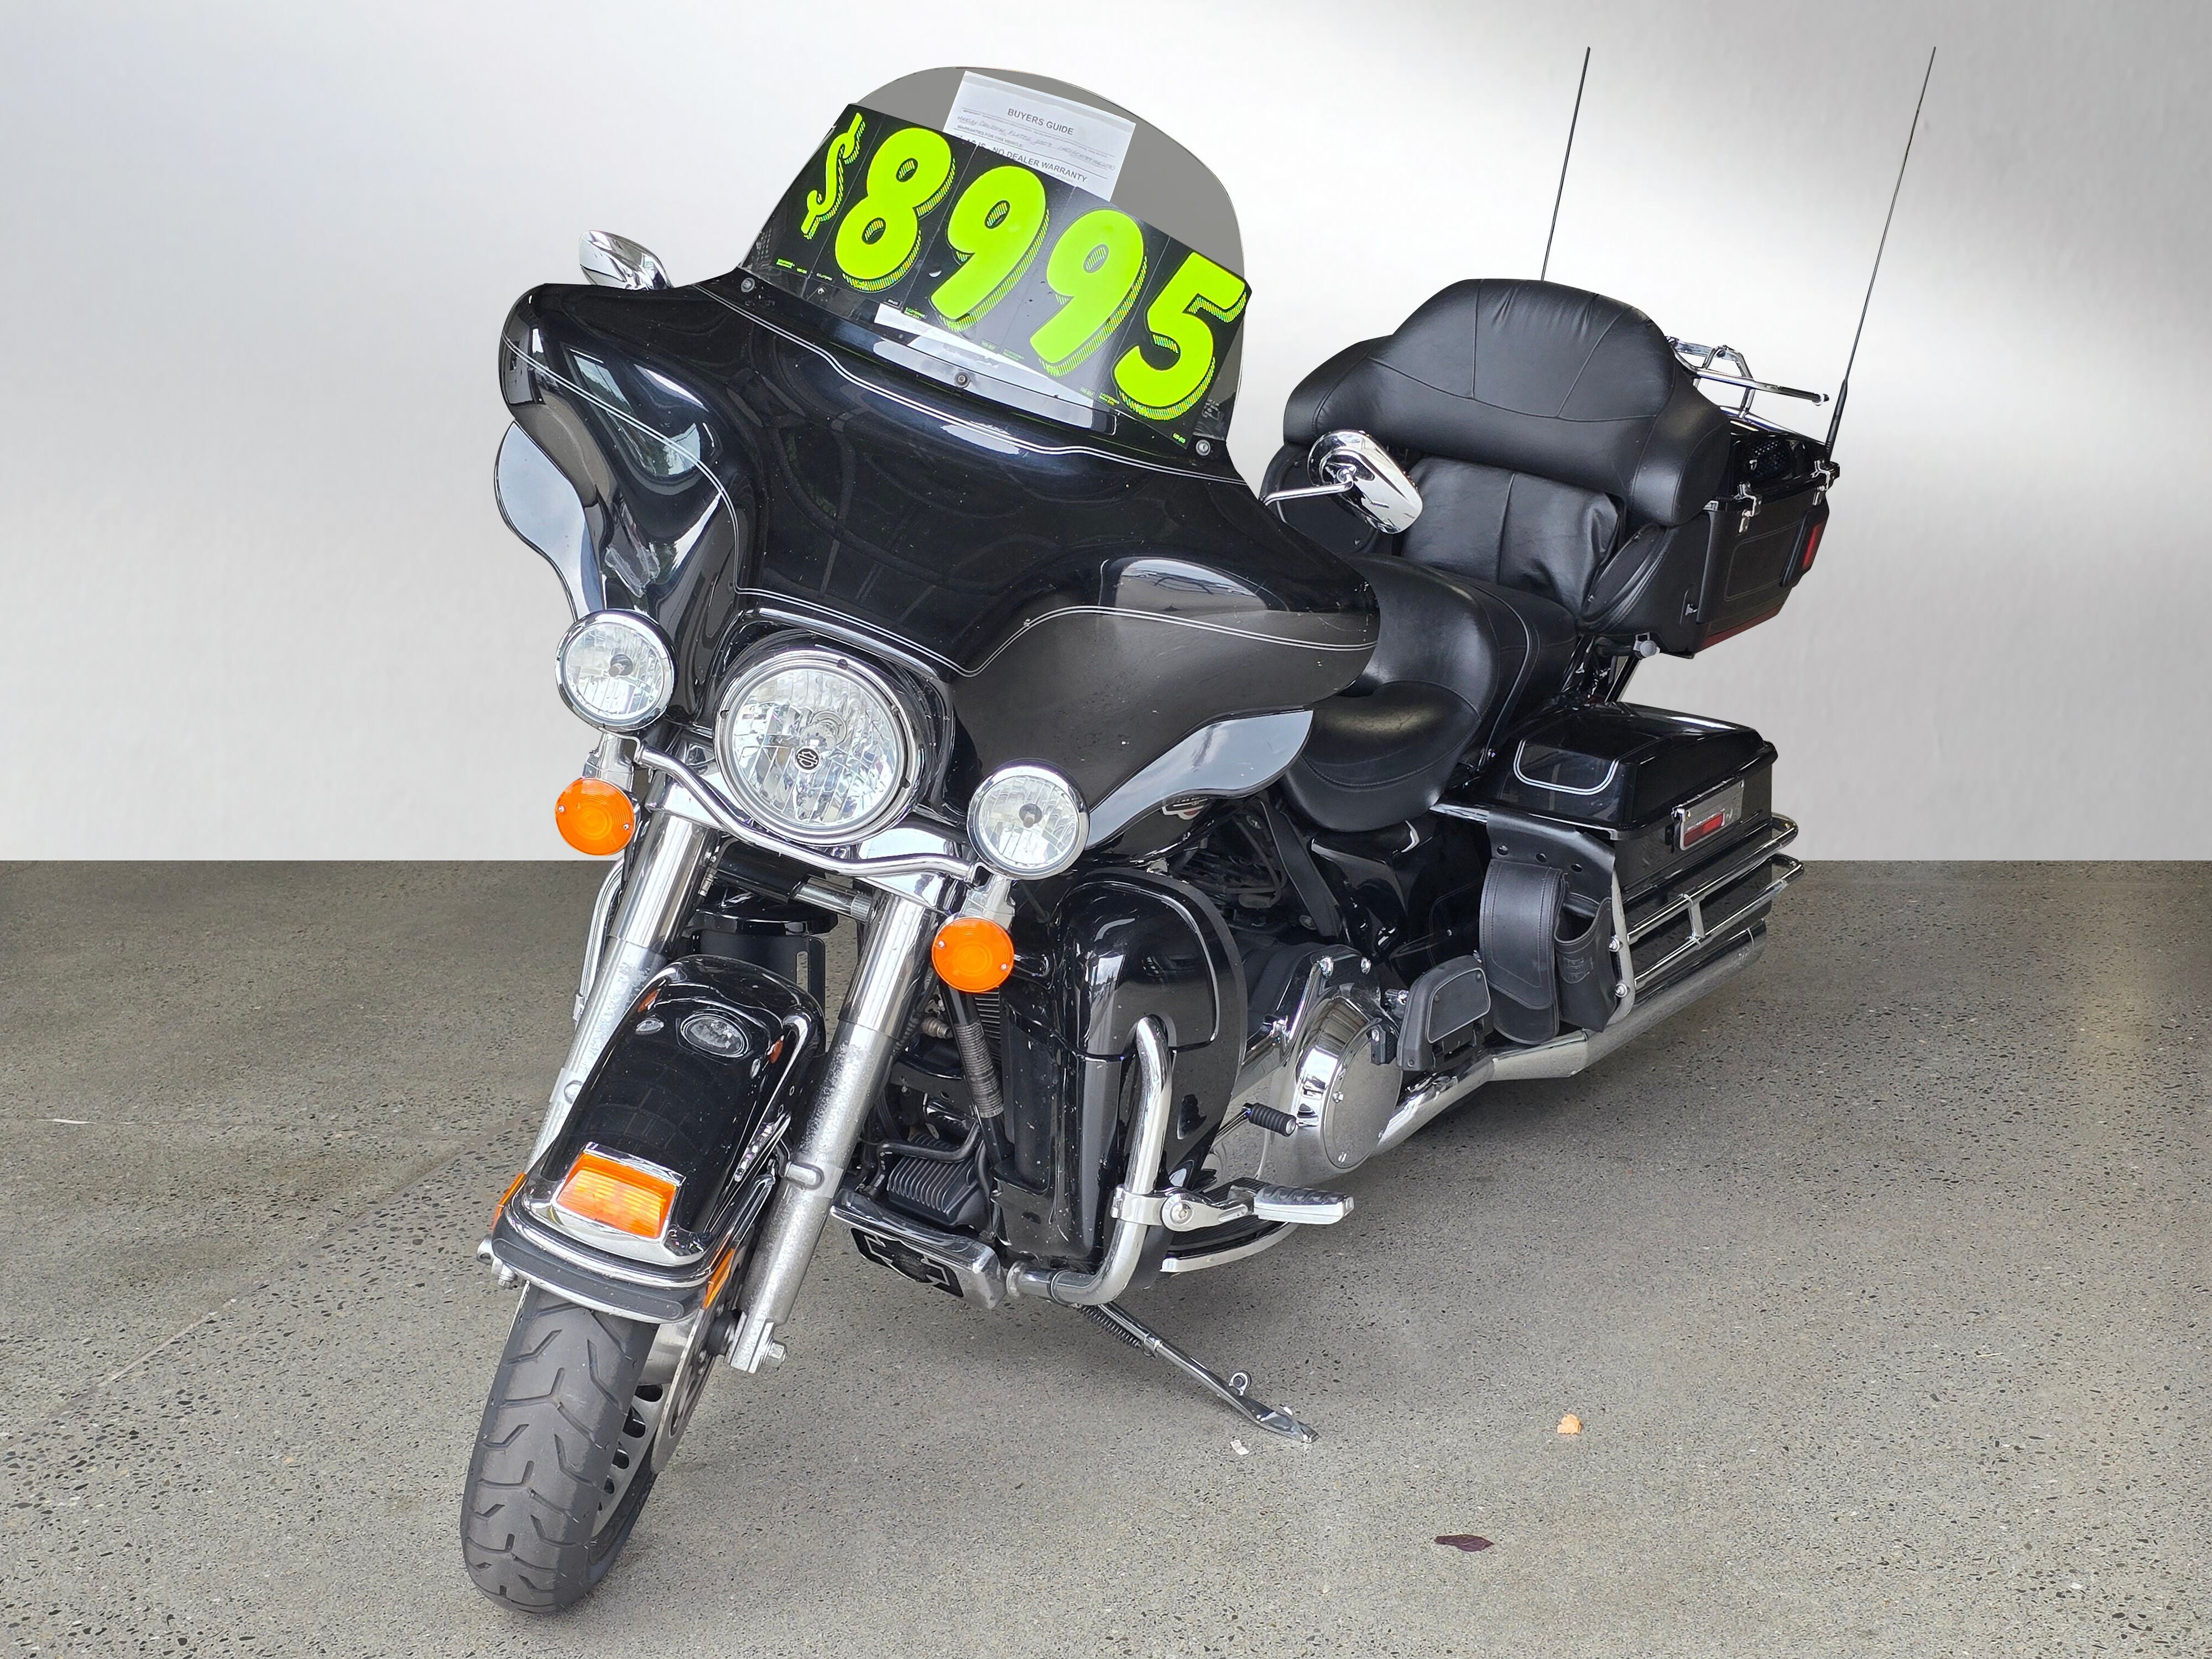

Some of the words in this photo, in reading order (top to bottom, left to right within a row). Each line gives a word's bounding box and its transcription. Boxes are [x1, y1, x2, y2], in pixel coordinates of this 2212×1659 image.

[1008, 108, 1044, 126] BUYERS
[1046, 121, 1074, 135] GUIDE
[1007, 150, 1040, 166] DEALER
[1042, 161, 1088, 182] WARRANTY
[800, 112, 1247, 421] $8995
